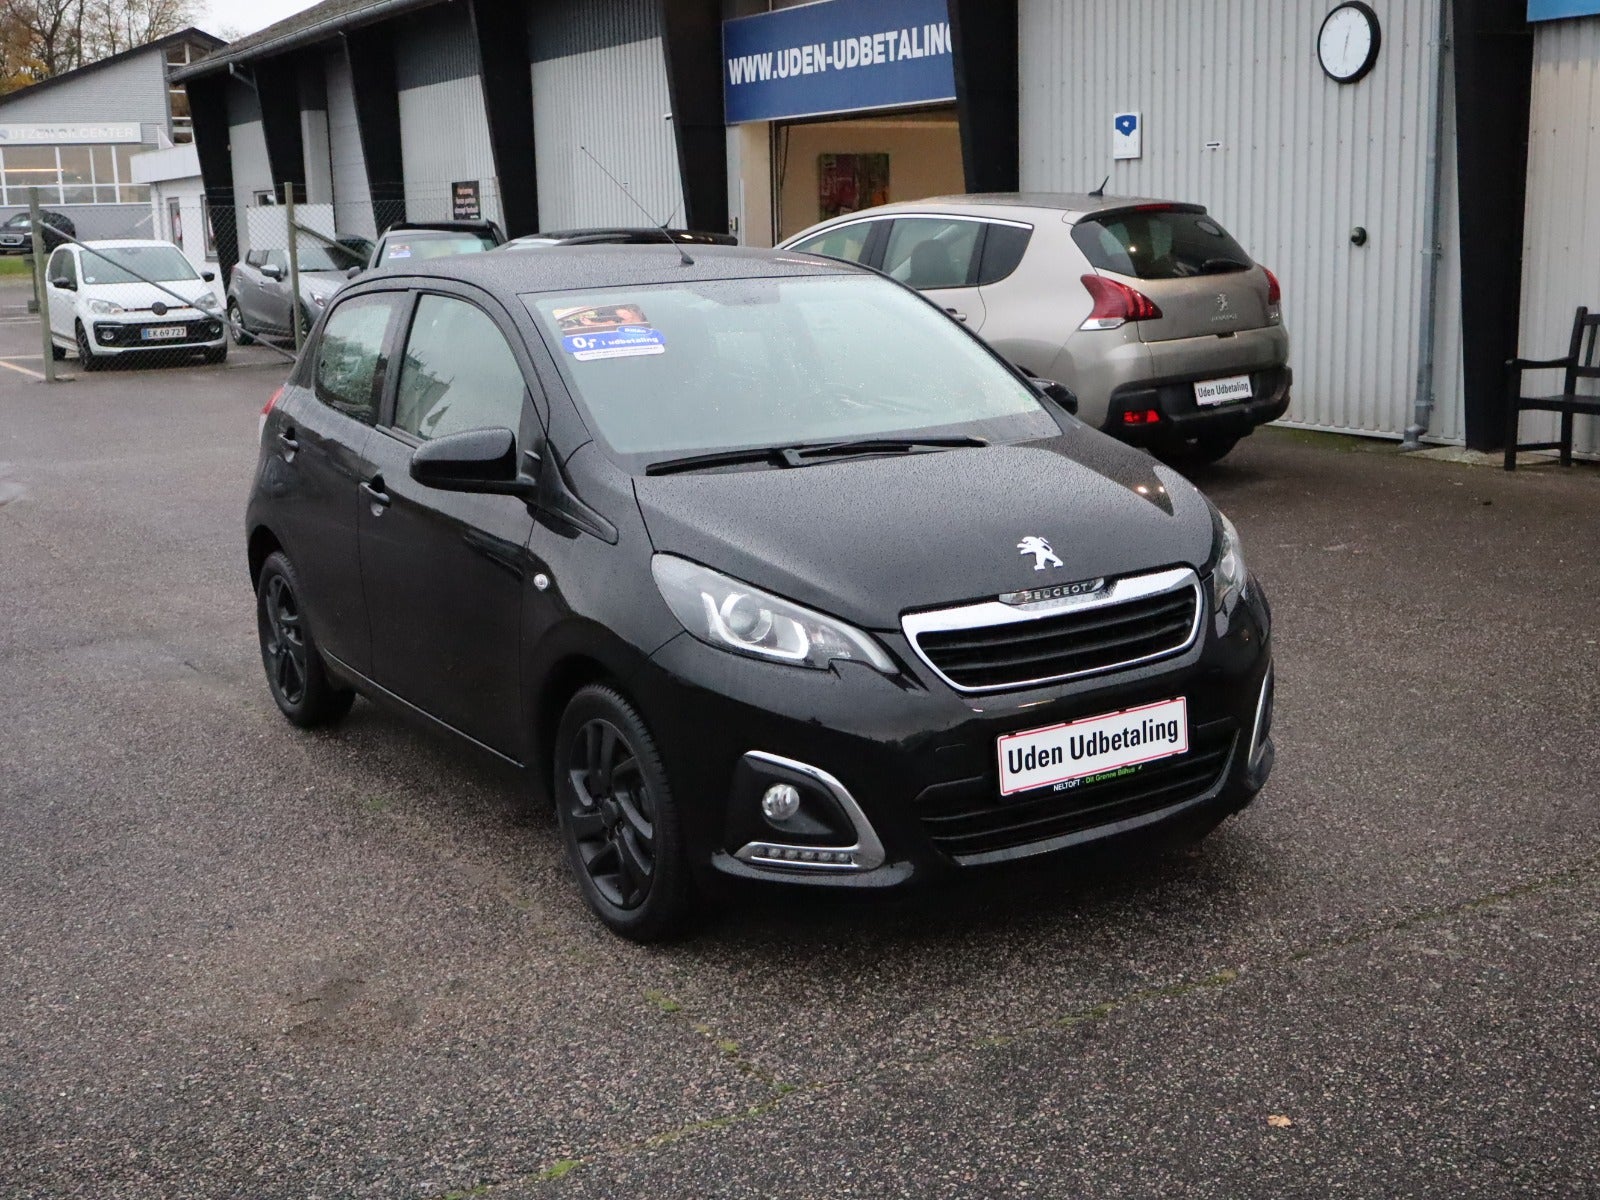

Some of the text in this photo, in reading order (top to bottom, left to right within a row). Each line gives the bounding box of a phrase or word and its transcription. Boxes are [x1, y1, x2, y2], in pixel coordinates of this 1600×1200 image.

[1197, 381, 1249, 397] Uden Udbetaling
[1024, 583, 1088, 600] PEUGEOT
[1008, 718, 1178, 774] Uden Udbetaling
[1053, 779, 1081, 792] NELTOFT
